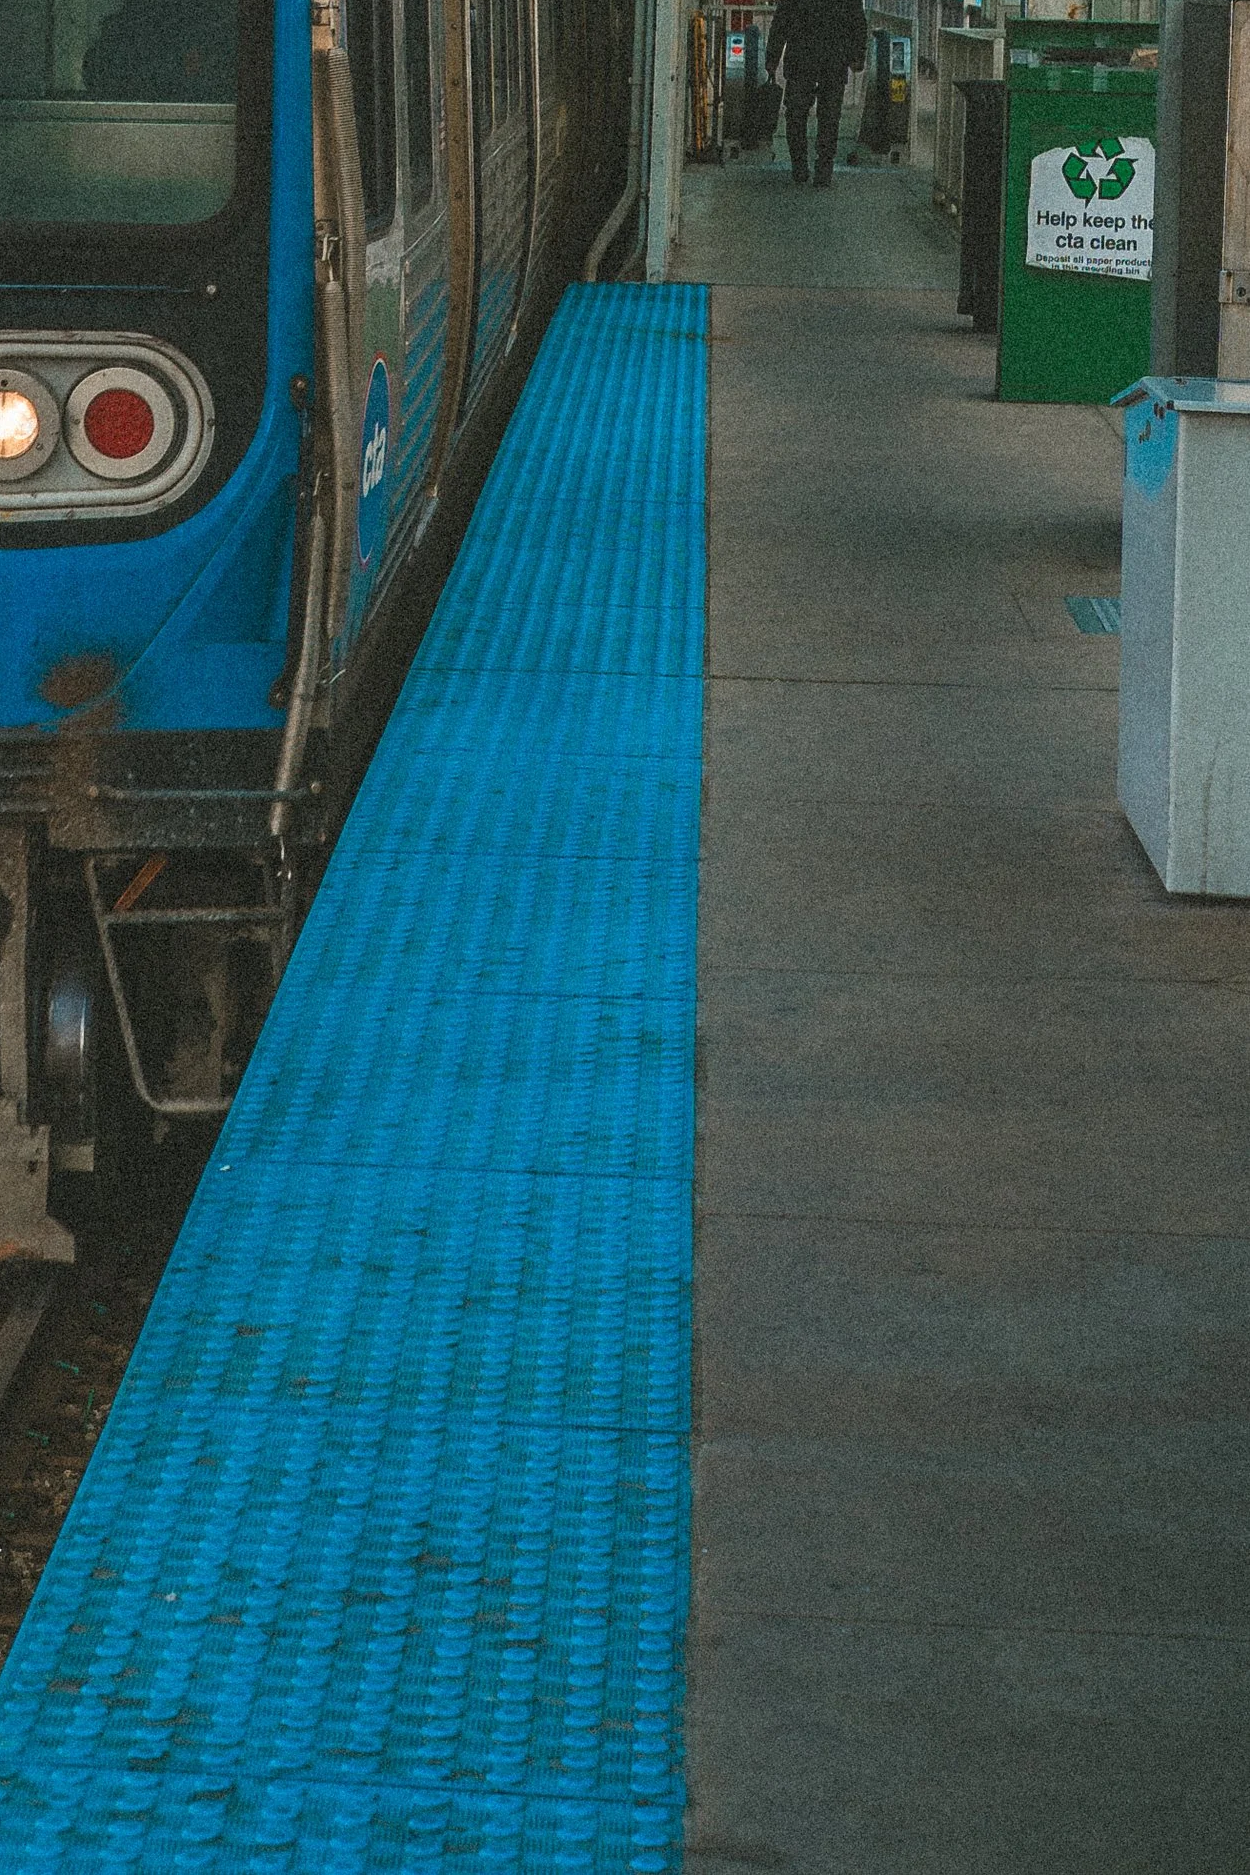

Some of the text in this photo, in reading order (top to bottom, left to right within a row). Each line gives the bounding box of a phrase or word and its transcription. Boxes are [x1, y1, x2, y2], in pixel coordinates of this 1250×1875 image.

[1036, 210, 1078, 230] Help
[1083, 212, 1126, 232] keep
[1055, 233, 1138, 251] cta clean
[1035, 253, 1152, 267] Deposit all paper product
[1125, 266, 1140, 275] bin
